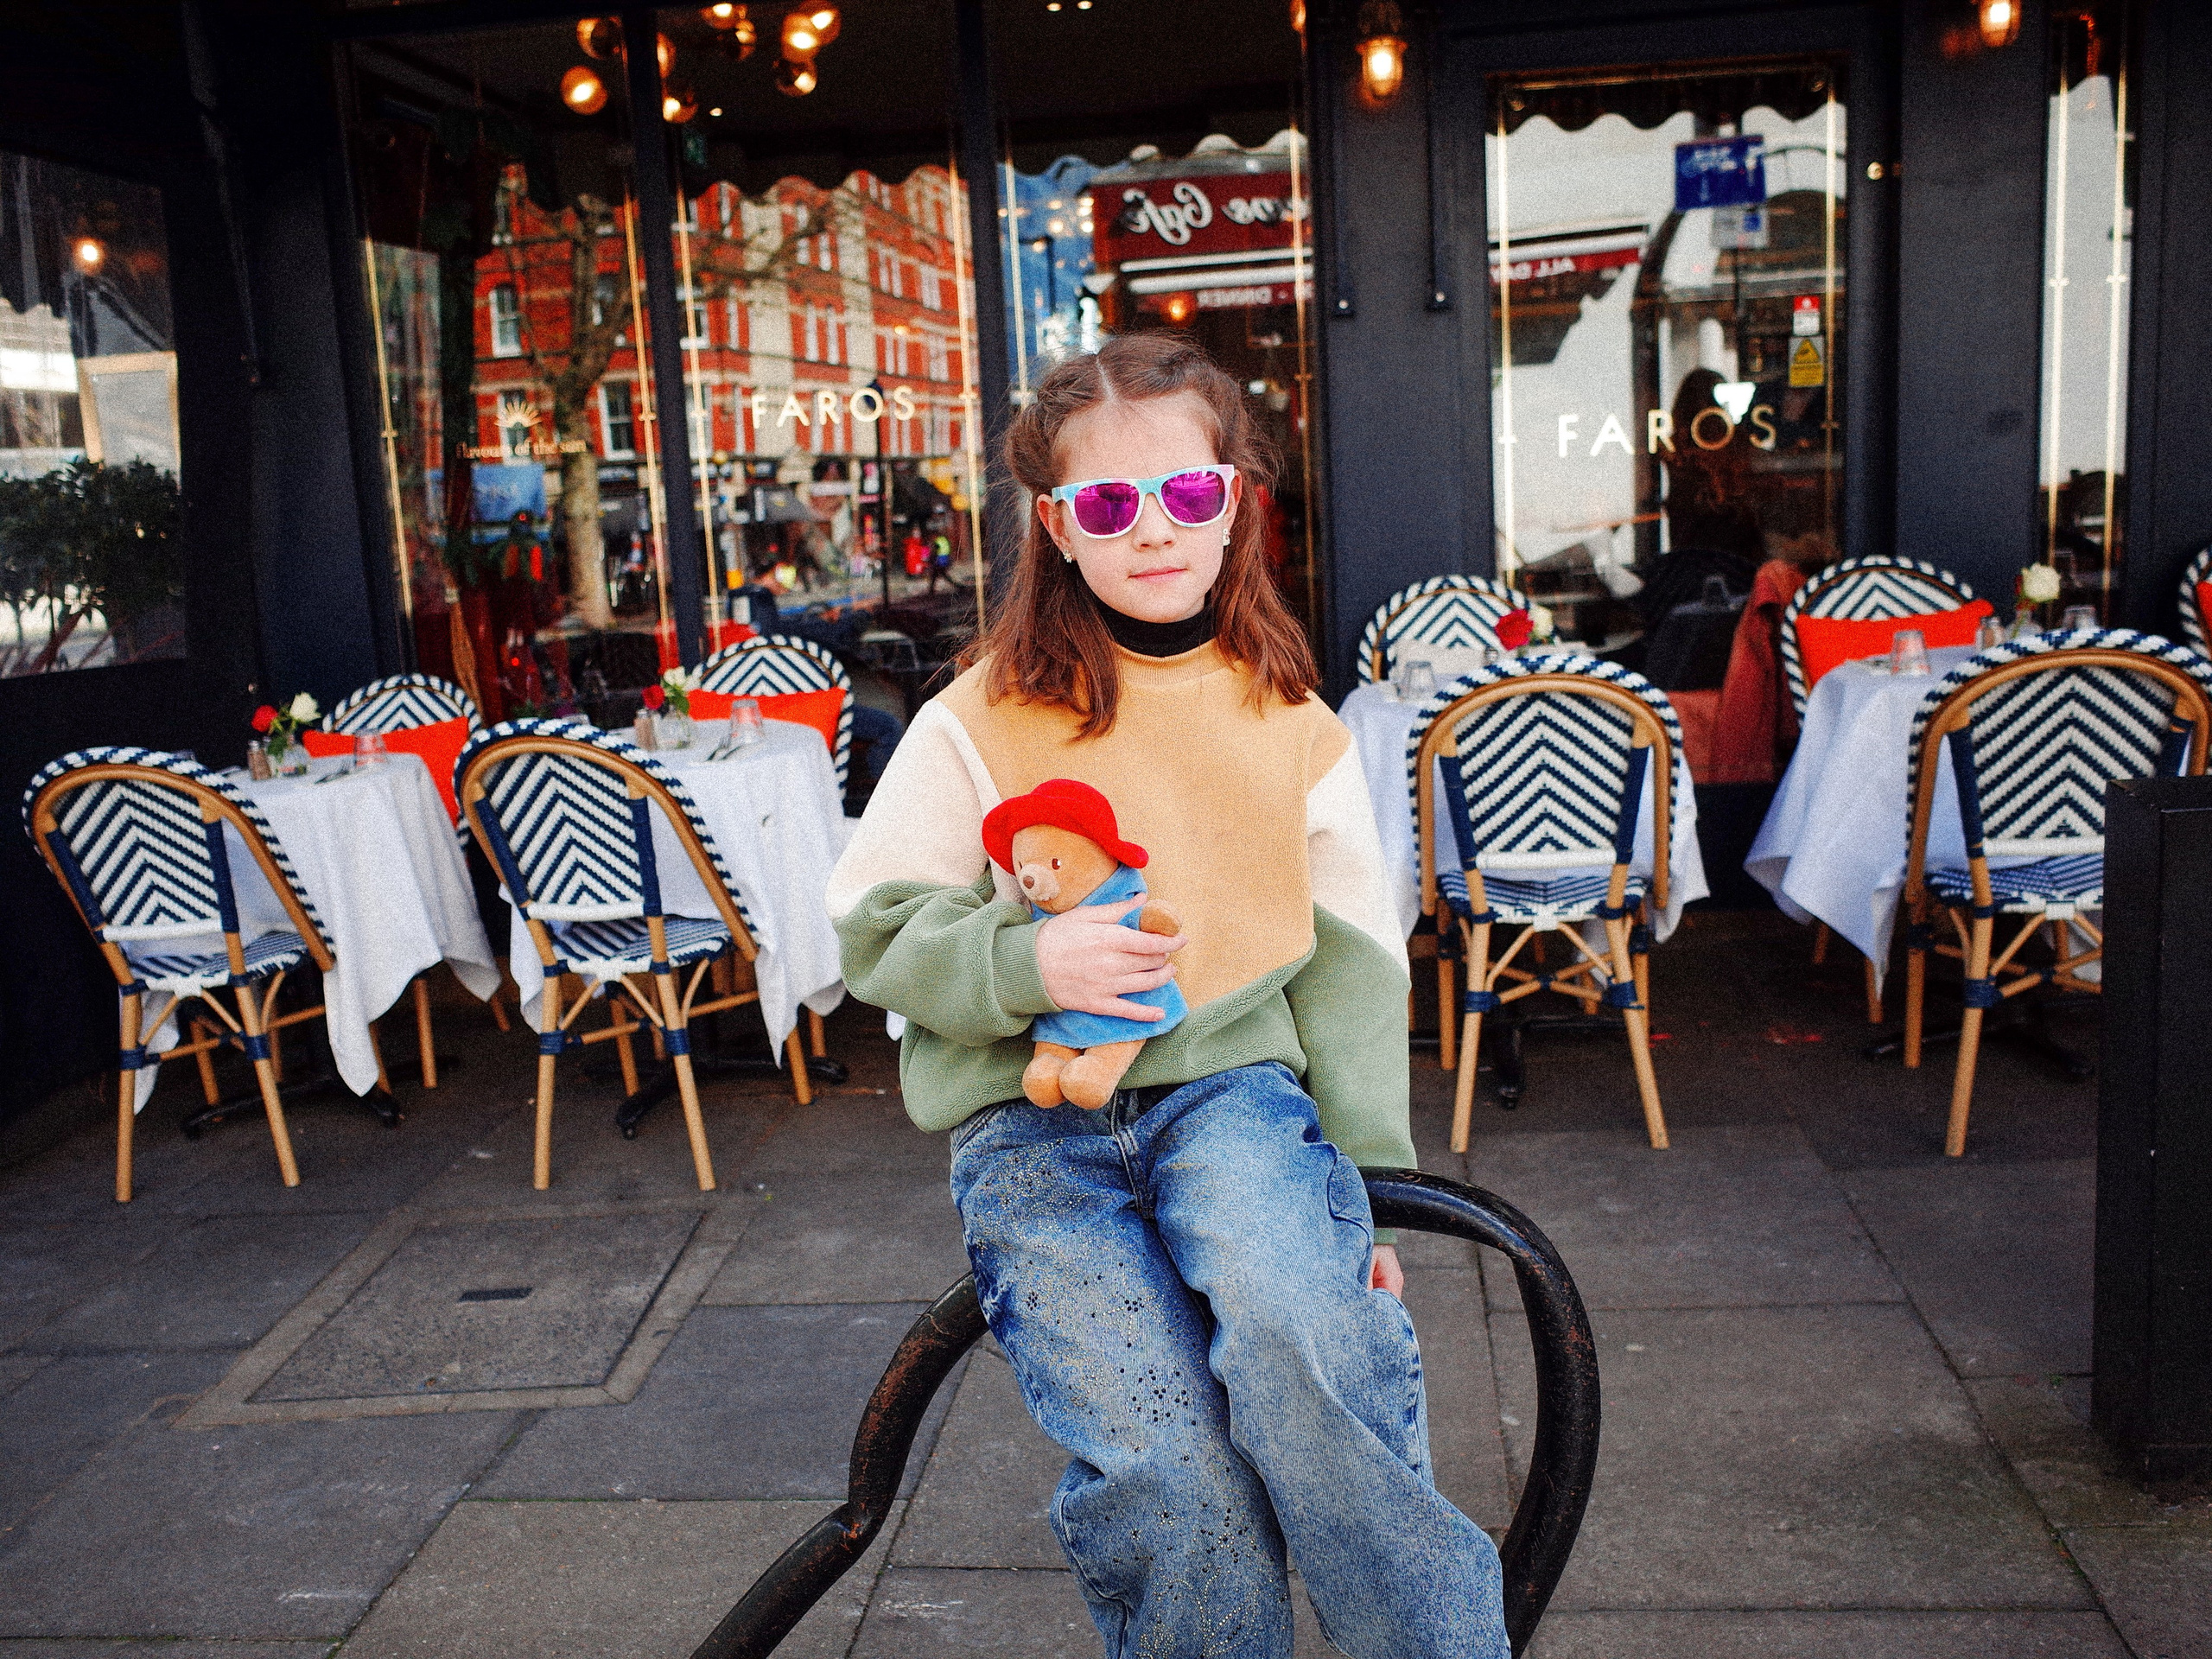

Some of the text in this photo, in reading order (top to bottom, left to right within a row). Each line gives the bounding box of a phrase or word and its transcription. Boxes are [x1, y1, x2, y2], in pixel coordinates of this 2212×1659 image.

[751, 385, 916, 429] FAROS
[515, 437, 531, 456] of
[1558, 404, 1777, 459] FAROS
